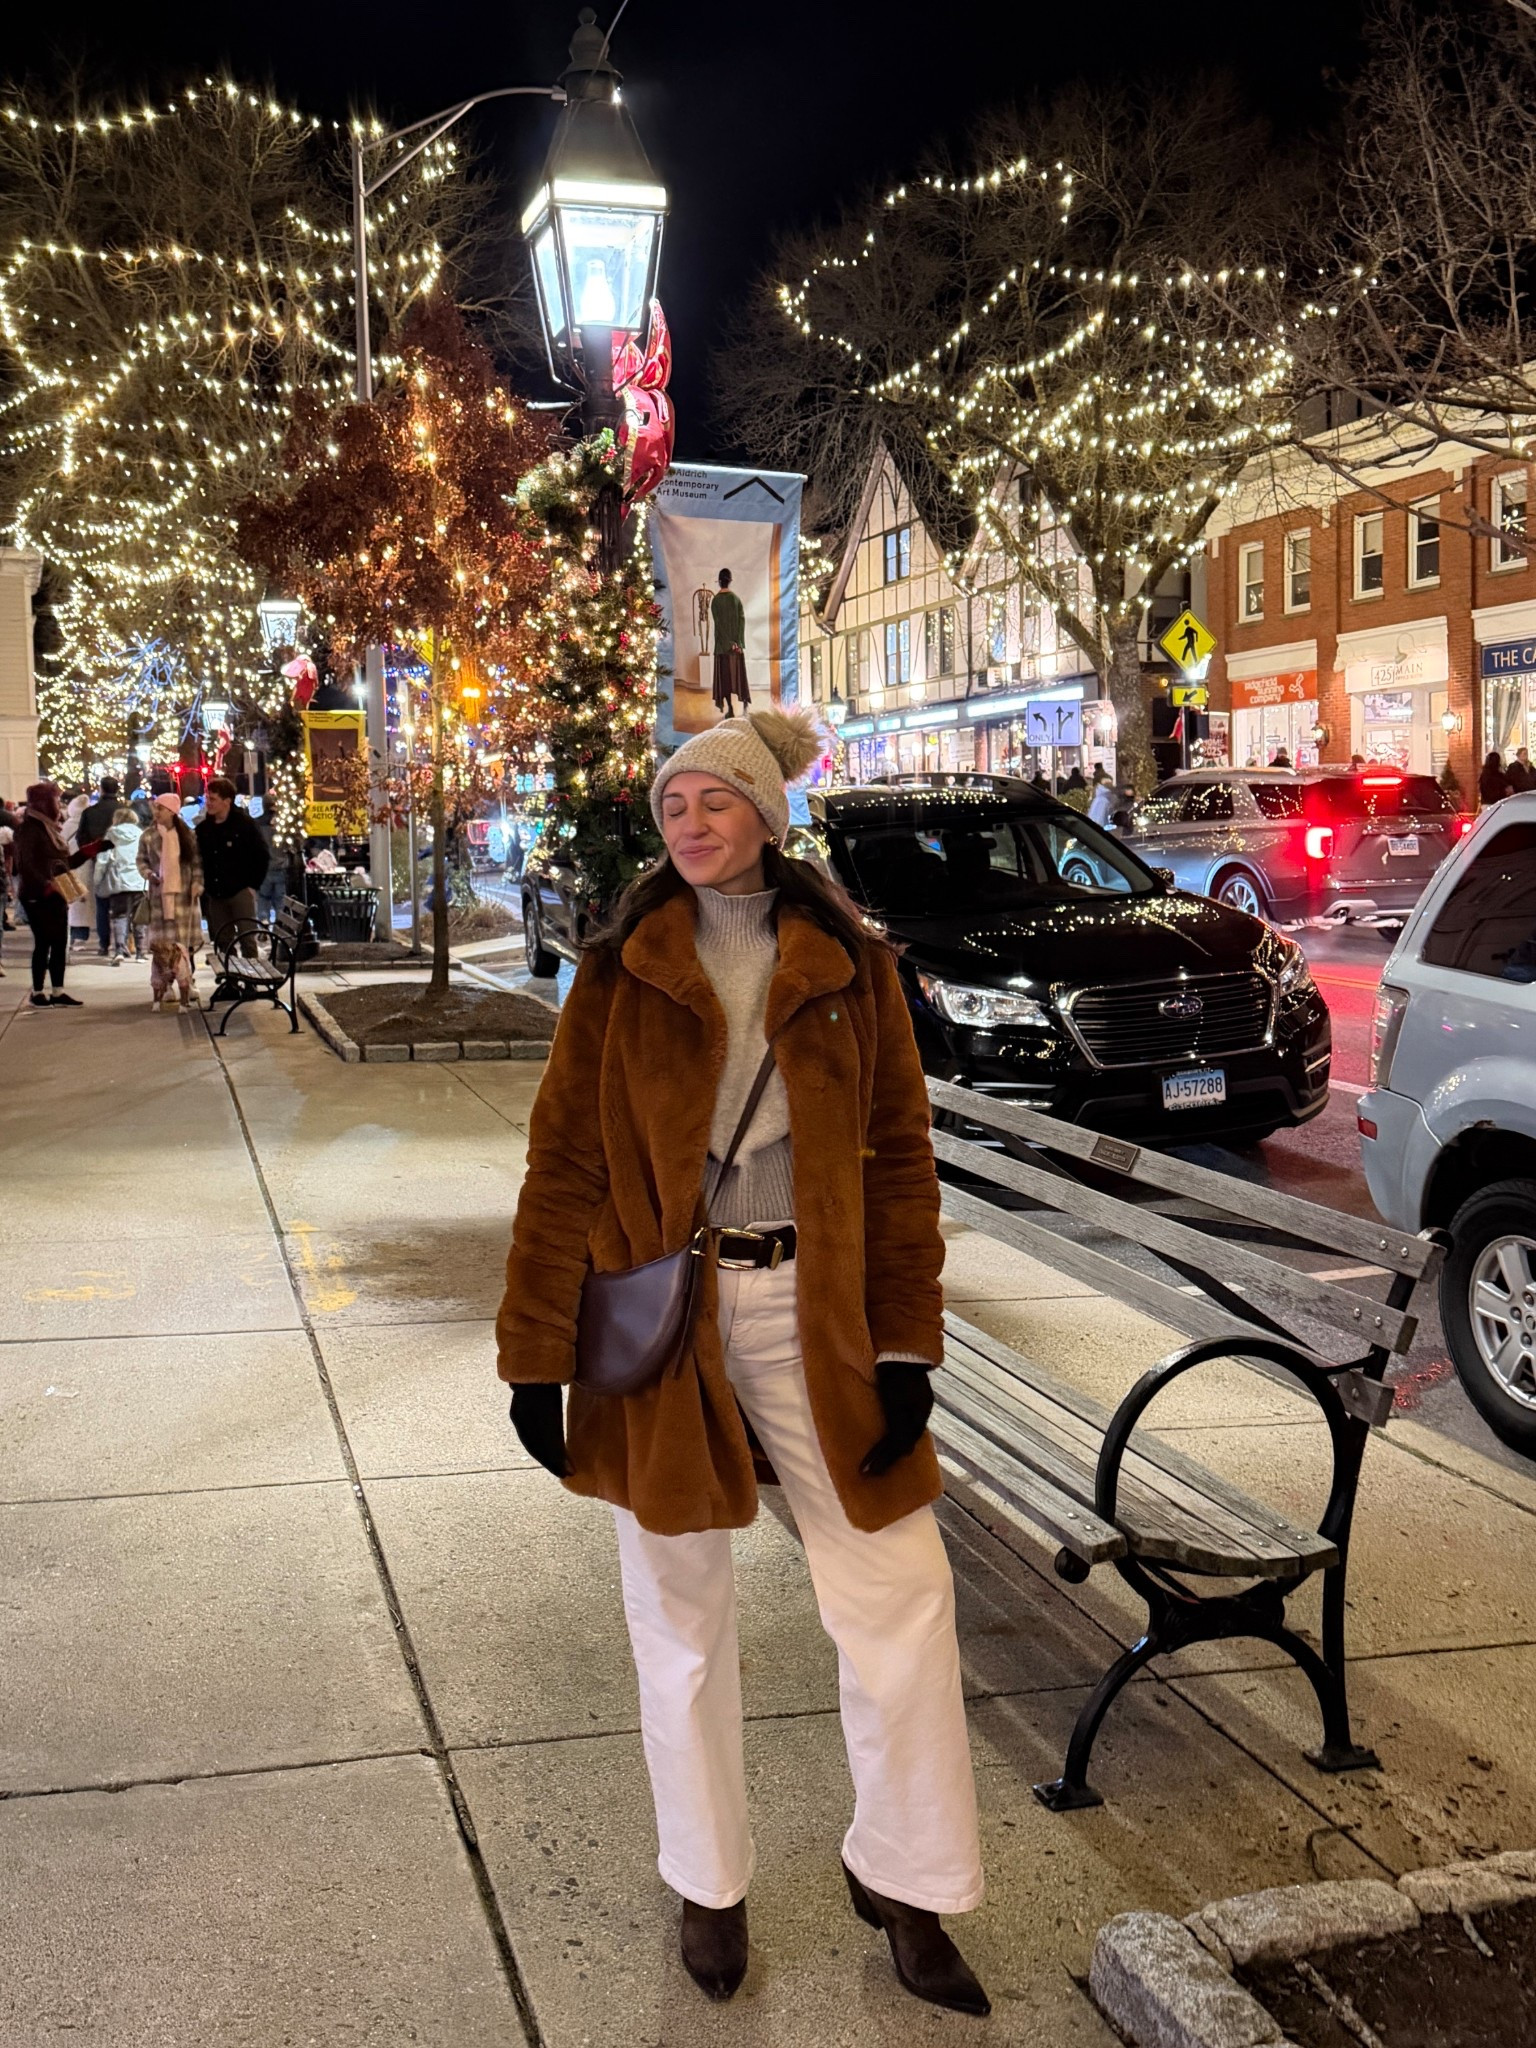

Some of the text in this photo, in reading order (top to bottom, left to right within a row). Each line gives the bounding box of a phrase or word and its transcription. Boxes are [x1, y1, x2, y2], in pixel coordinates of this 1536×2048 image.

[675, 468, 708, 478] Aldrich
[660, 479, 719, 491] ontemporary
[656, 487, 707, 499] Art Museum
[1491, 650, 1518, 668] THE
[1374, 662, 1423, 681] 425 MAIN
[1029, 734, 1051, 742] ONLY
